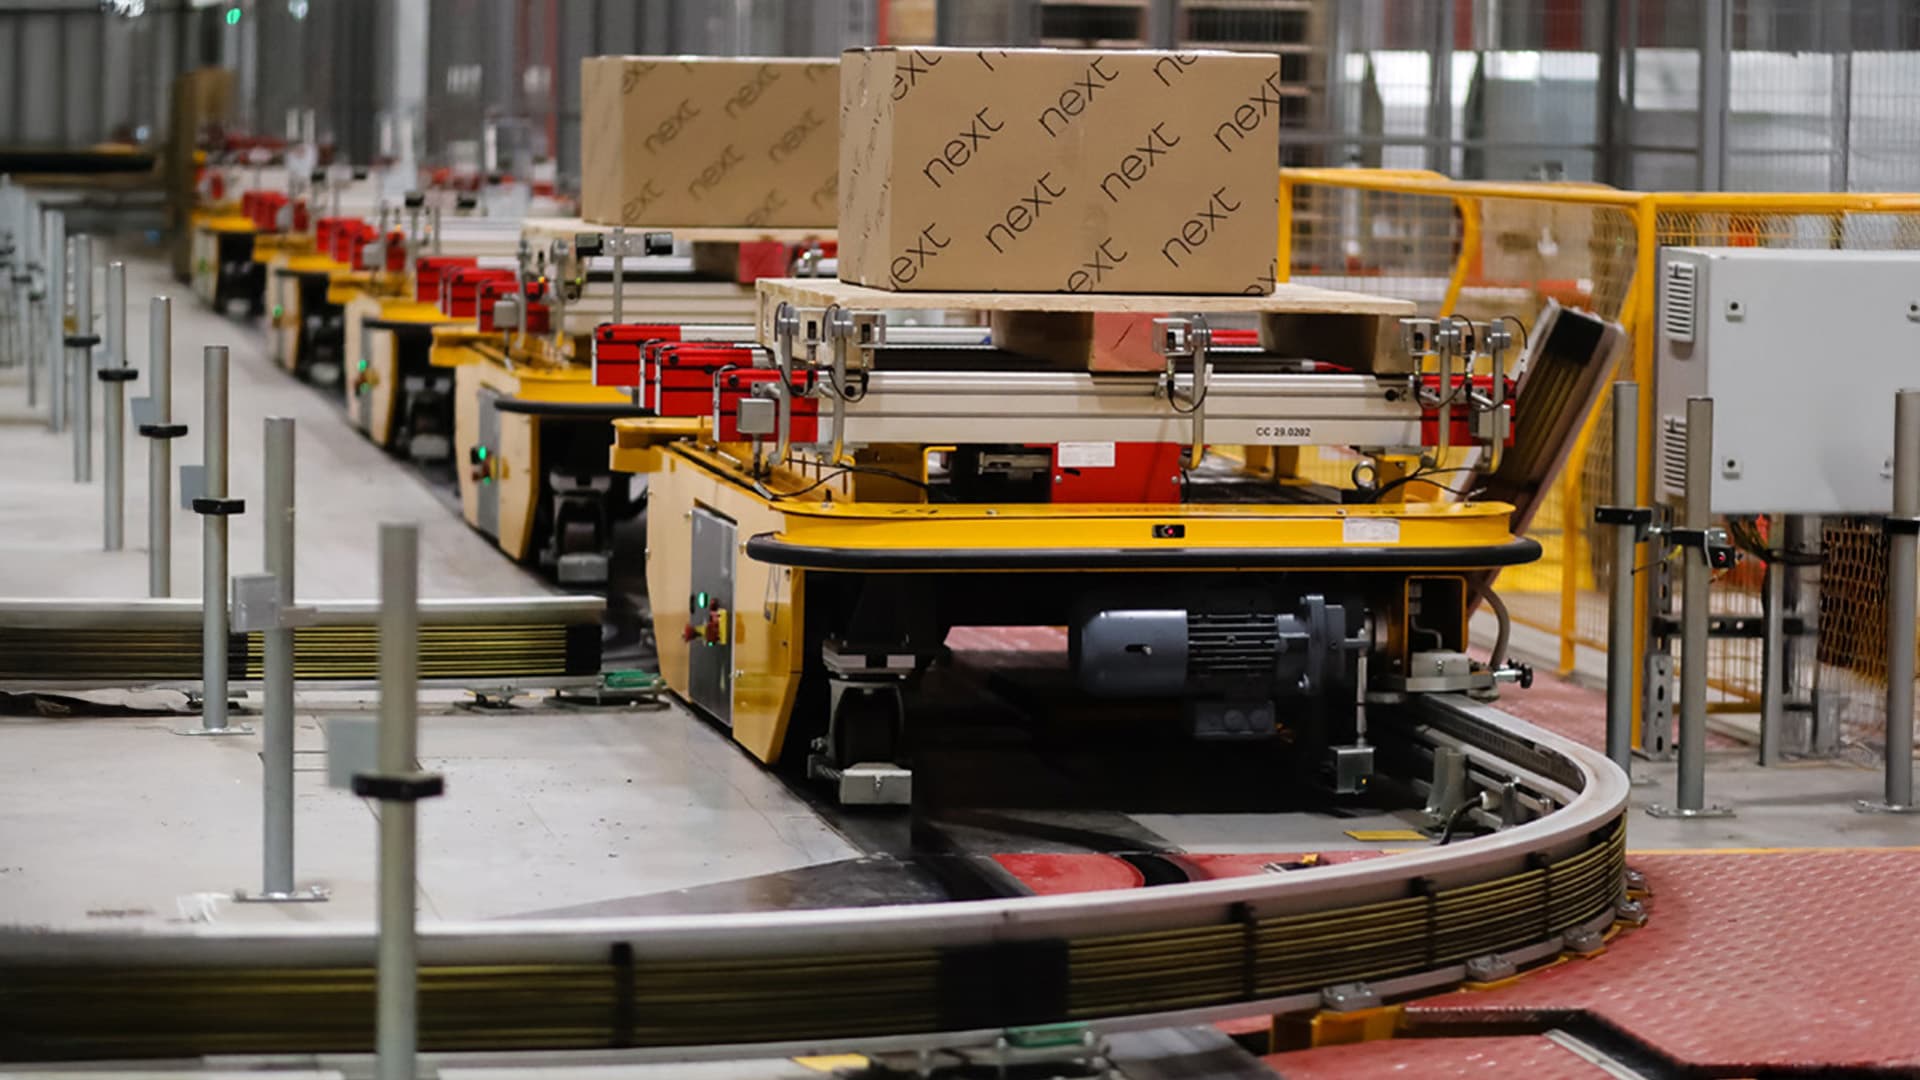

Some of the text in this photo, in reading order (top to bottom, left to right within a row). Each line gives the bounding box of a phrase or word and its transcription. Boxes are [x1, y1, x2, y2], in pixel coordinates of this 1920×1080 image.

[724, 63, 781, 119] next
[892, 49, 942, 101] ext
[1038, 56, 1119, 137] next
[644, 98, 701, 154] next
[768, 106, 826, 164] next
[1214, 71, 1280, 153] next
[688, 144, 746, 201] next
[922, 107, 1005, 188] next
[1100, 122, 1180, 202] next
[623, 178, 665, 227] ext
[745, 187, 788, 227] ext
[986, 172, 1066, 253] next
[1161, 187, 1241, 267] next
[889, 223, 951, 290] ext
[1066, 237, 1128, 292] ext
[1255, 426, 1271, 437] CC
